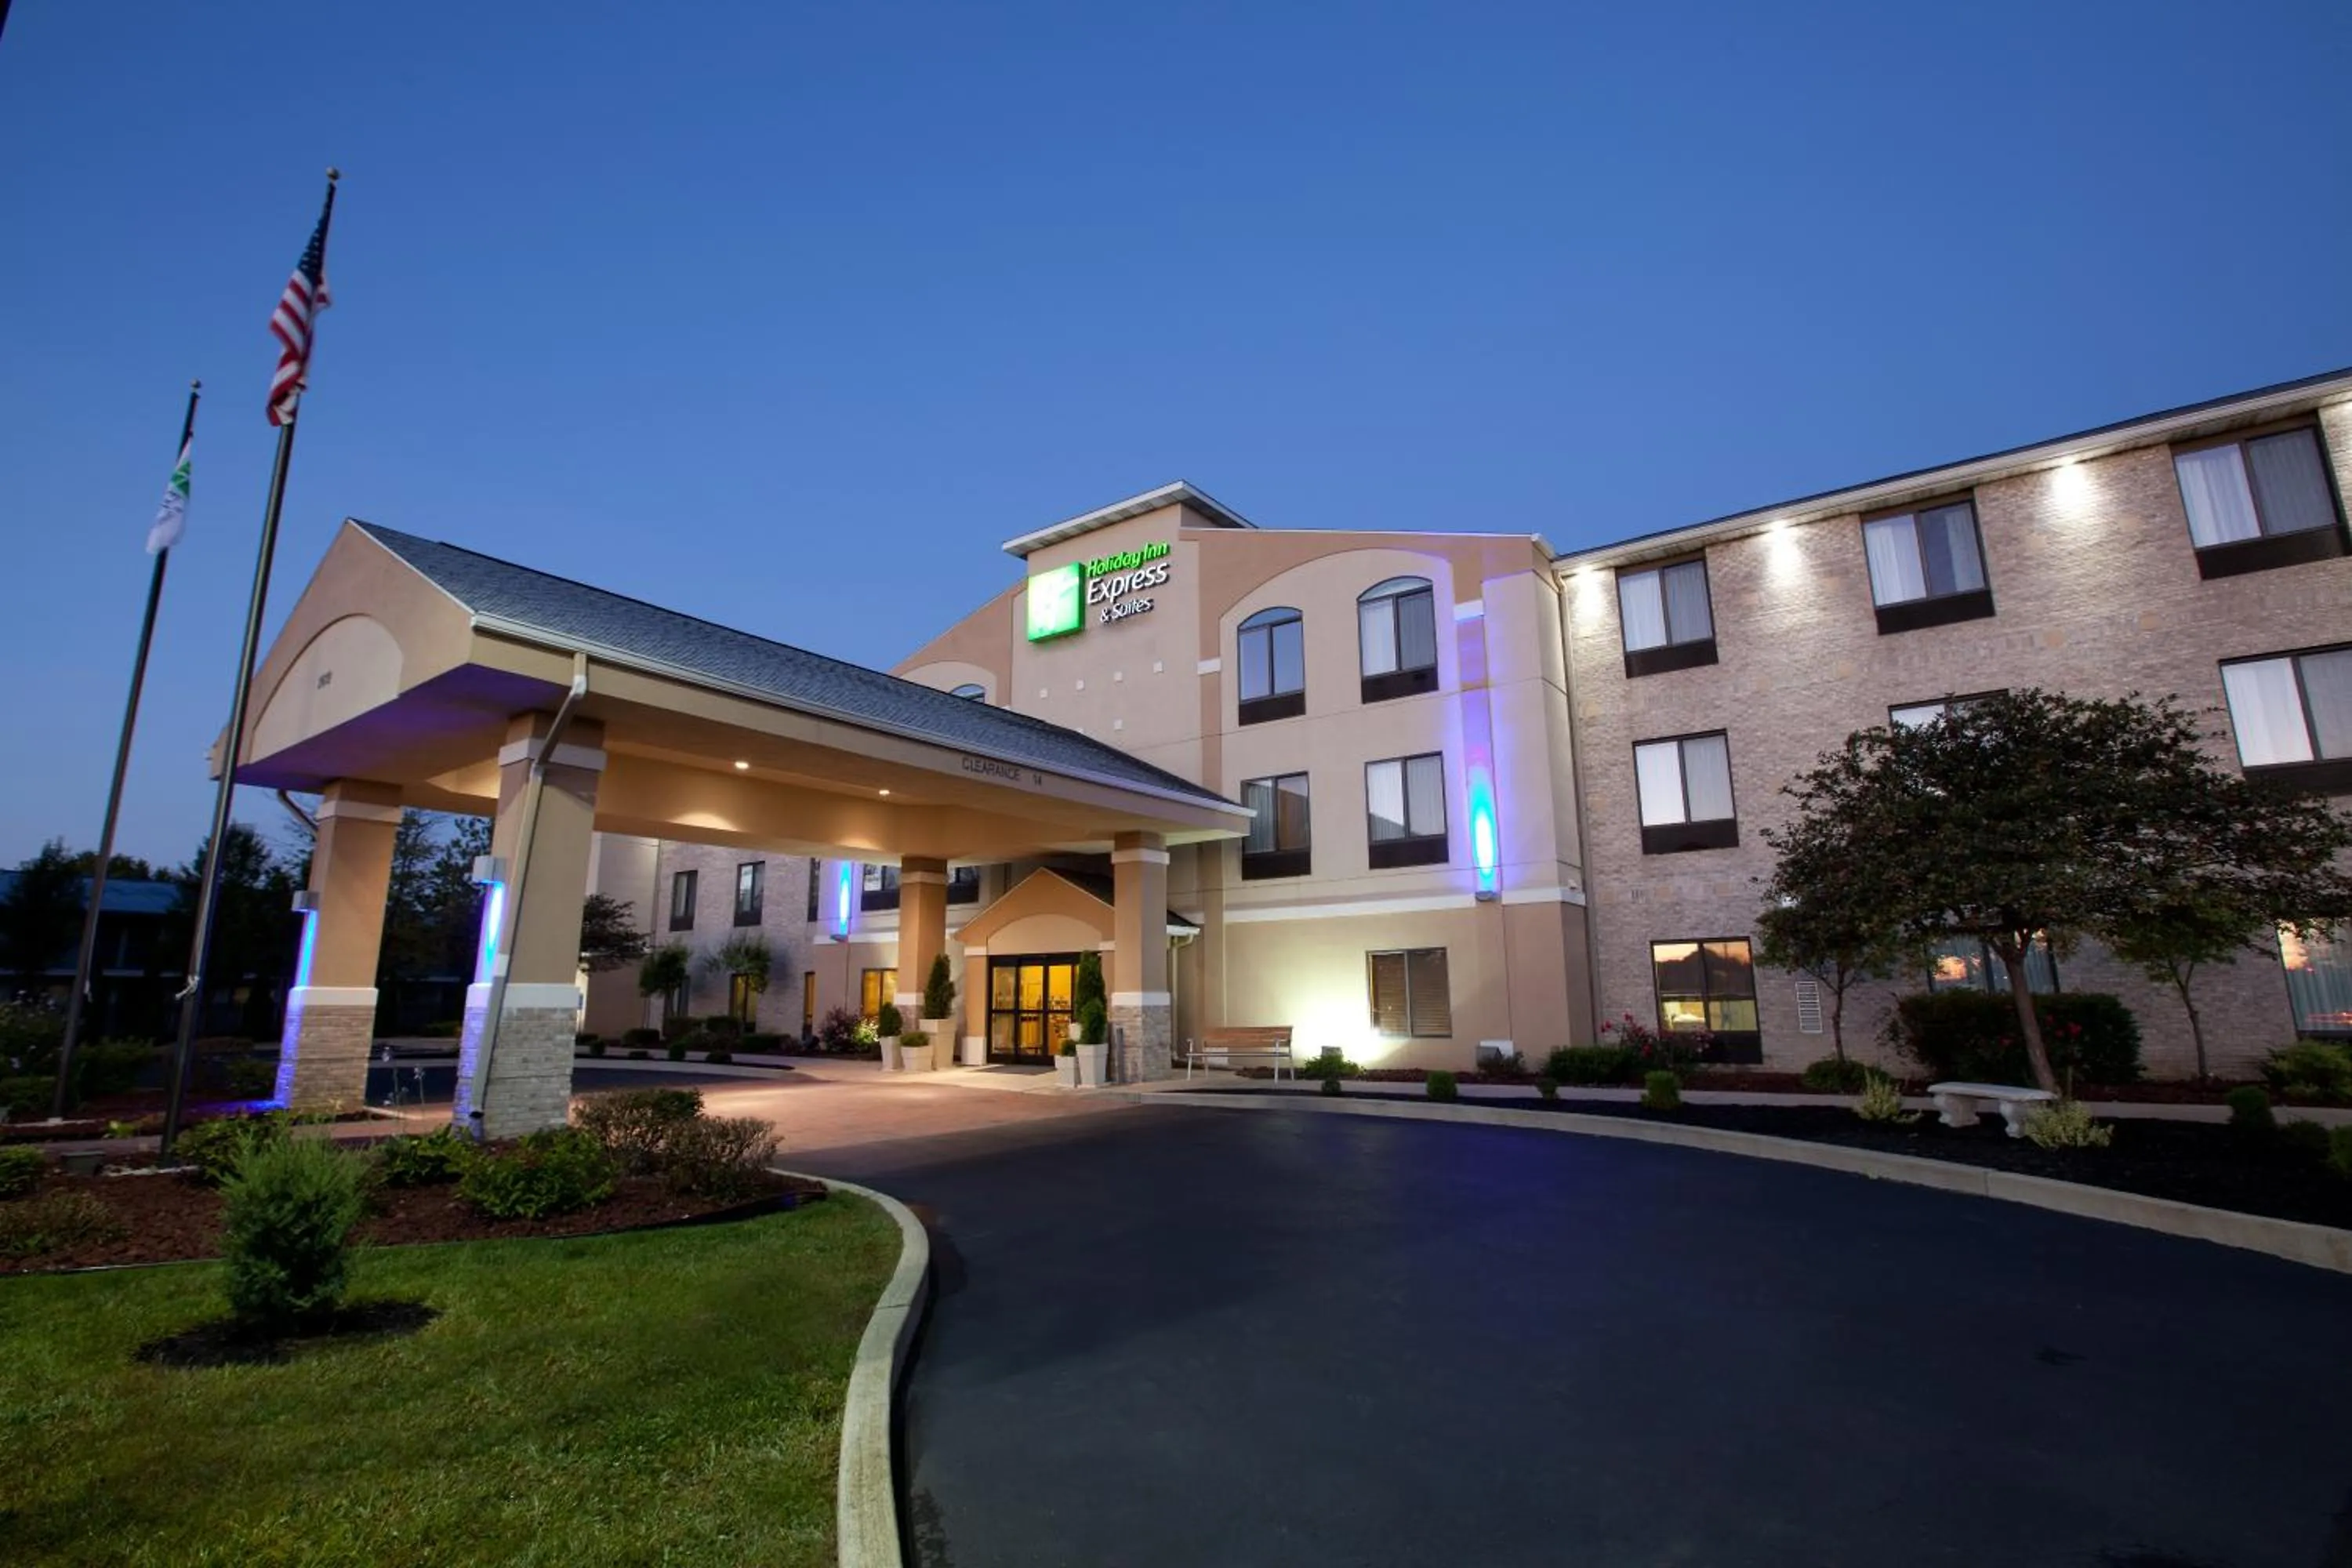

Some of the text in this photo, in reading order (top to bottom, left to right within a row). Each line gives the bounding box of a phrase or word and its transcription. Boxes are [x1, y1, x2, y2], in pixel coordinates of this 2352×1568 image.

[1087, 541, 1170, 577] Holiday Inn
[1087, 563, 1169, 604] Express
[1100, 597, 1153, 623] & Suites
[962, 757, 1021, 781] CLEARANCE
